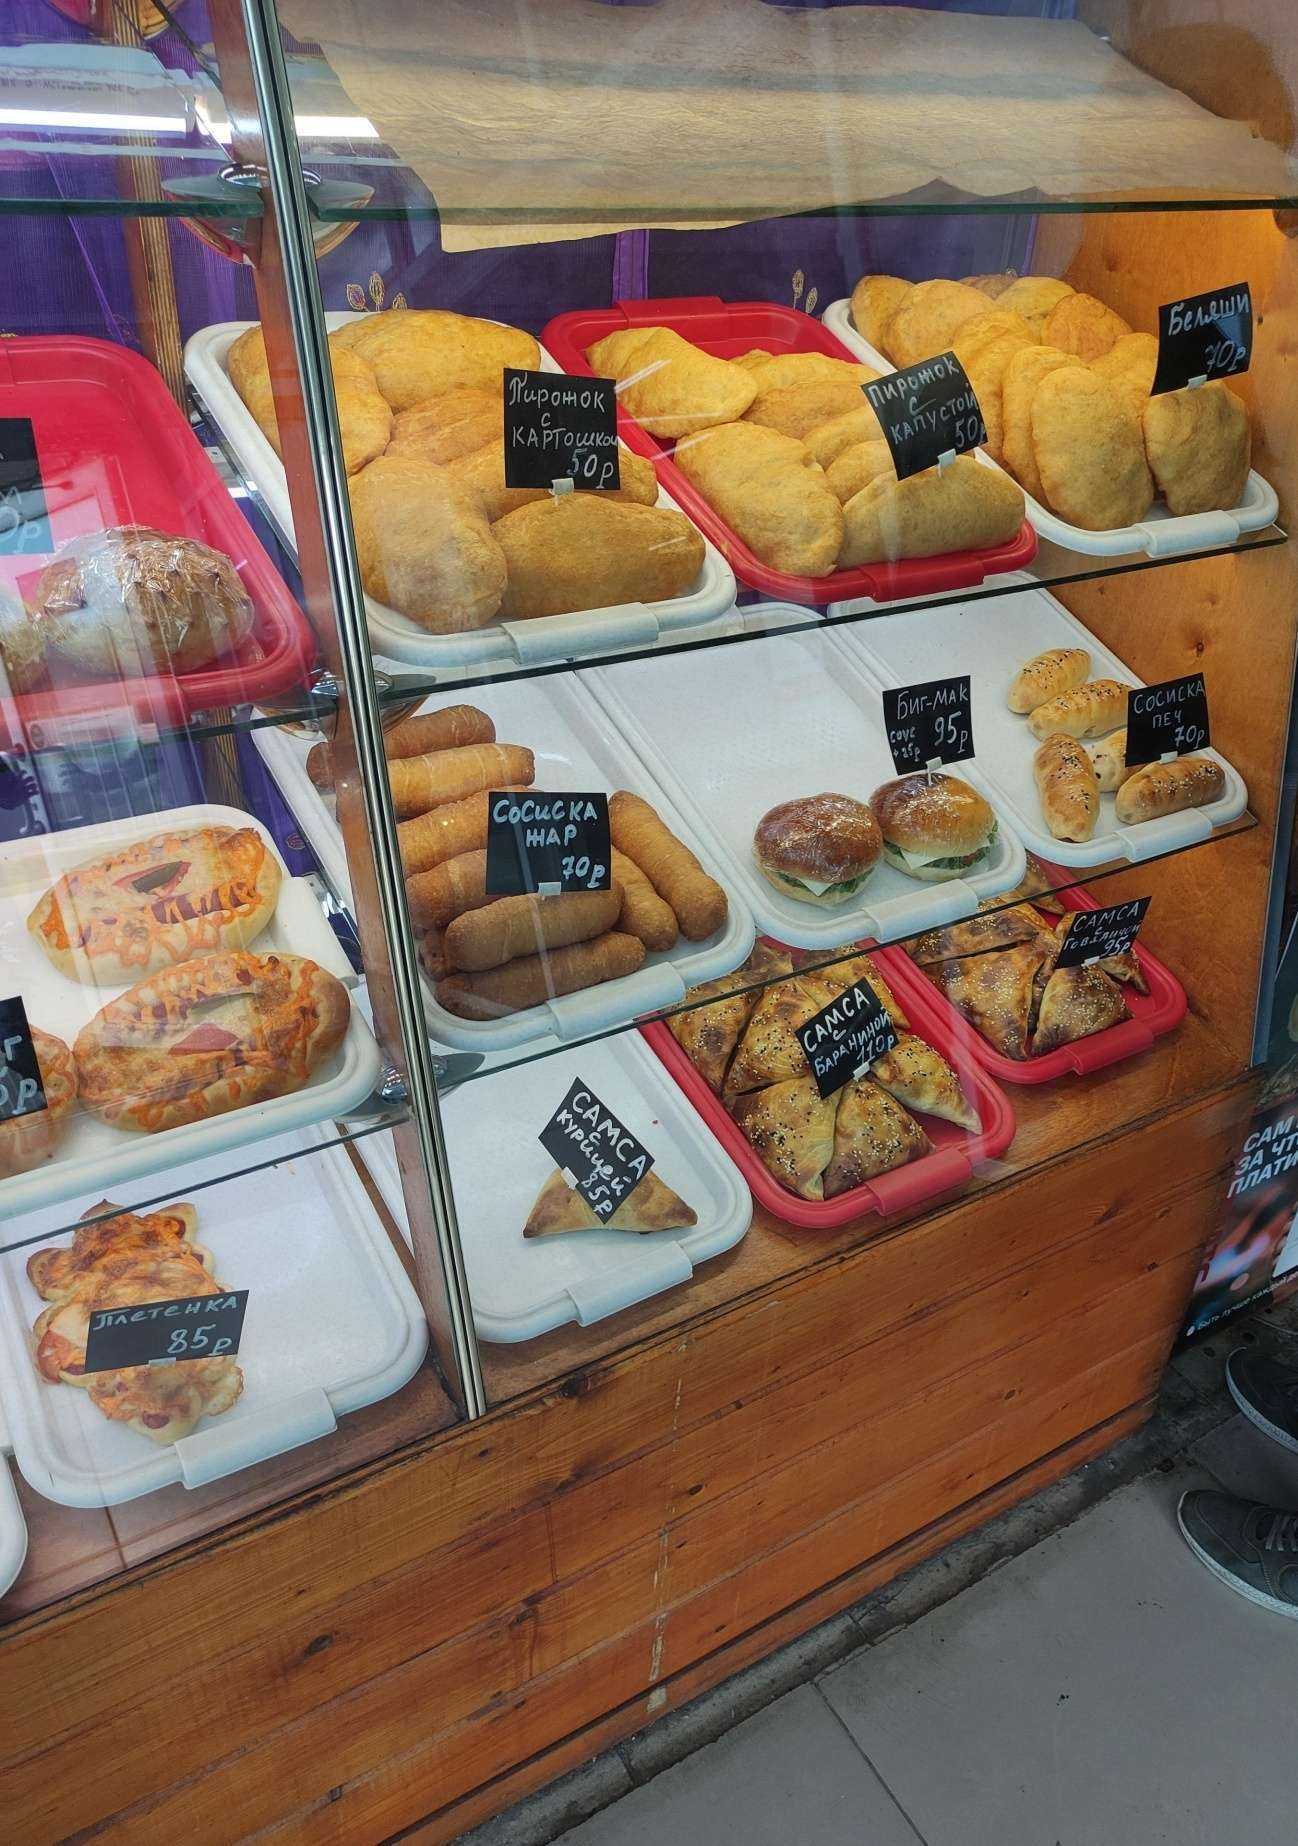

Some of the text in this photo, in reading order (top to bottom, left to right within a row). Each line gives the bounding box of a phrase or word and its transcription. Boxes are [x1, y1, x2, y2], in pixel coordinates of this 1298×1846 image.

[1168, 294, 1249, 336] Беляши
[509, 372, 604, 412] Пирожок
[566, 448, 614, 489] 50р
[897, 683, 968, 720] БИГ-МАК
[1134, 680, 1206, 714] СОСИСКА
[935, 711, 968, 754] 95р
[1152, 710, 1181, 729] ПЕЧ
[526, 824, 578, 847] ЖАР
[1073, 901, 1140, 933] САМСА
[803, 987, 871, 1053] САМСА
[572, 1091, 647, 1181] САМСА
[1234, 1132, 1298, 1176] ЗА ЧТ
[1243, 1115, 1296, 1153] САМ
